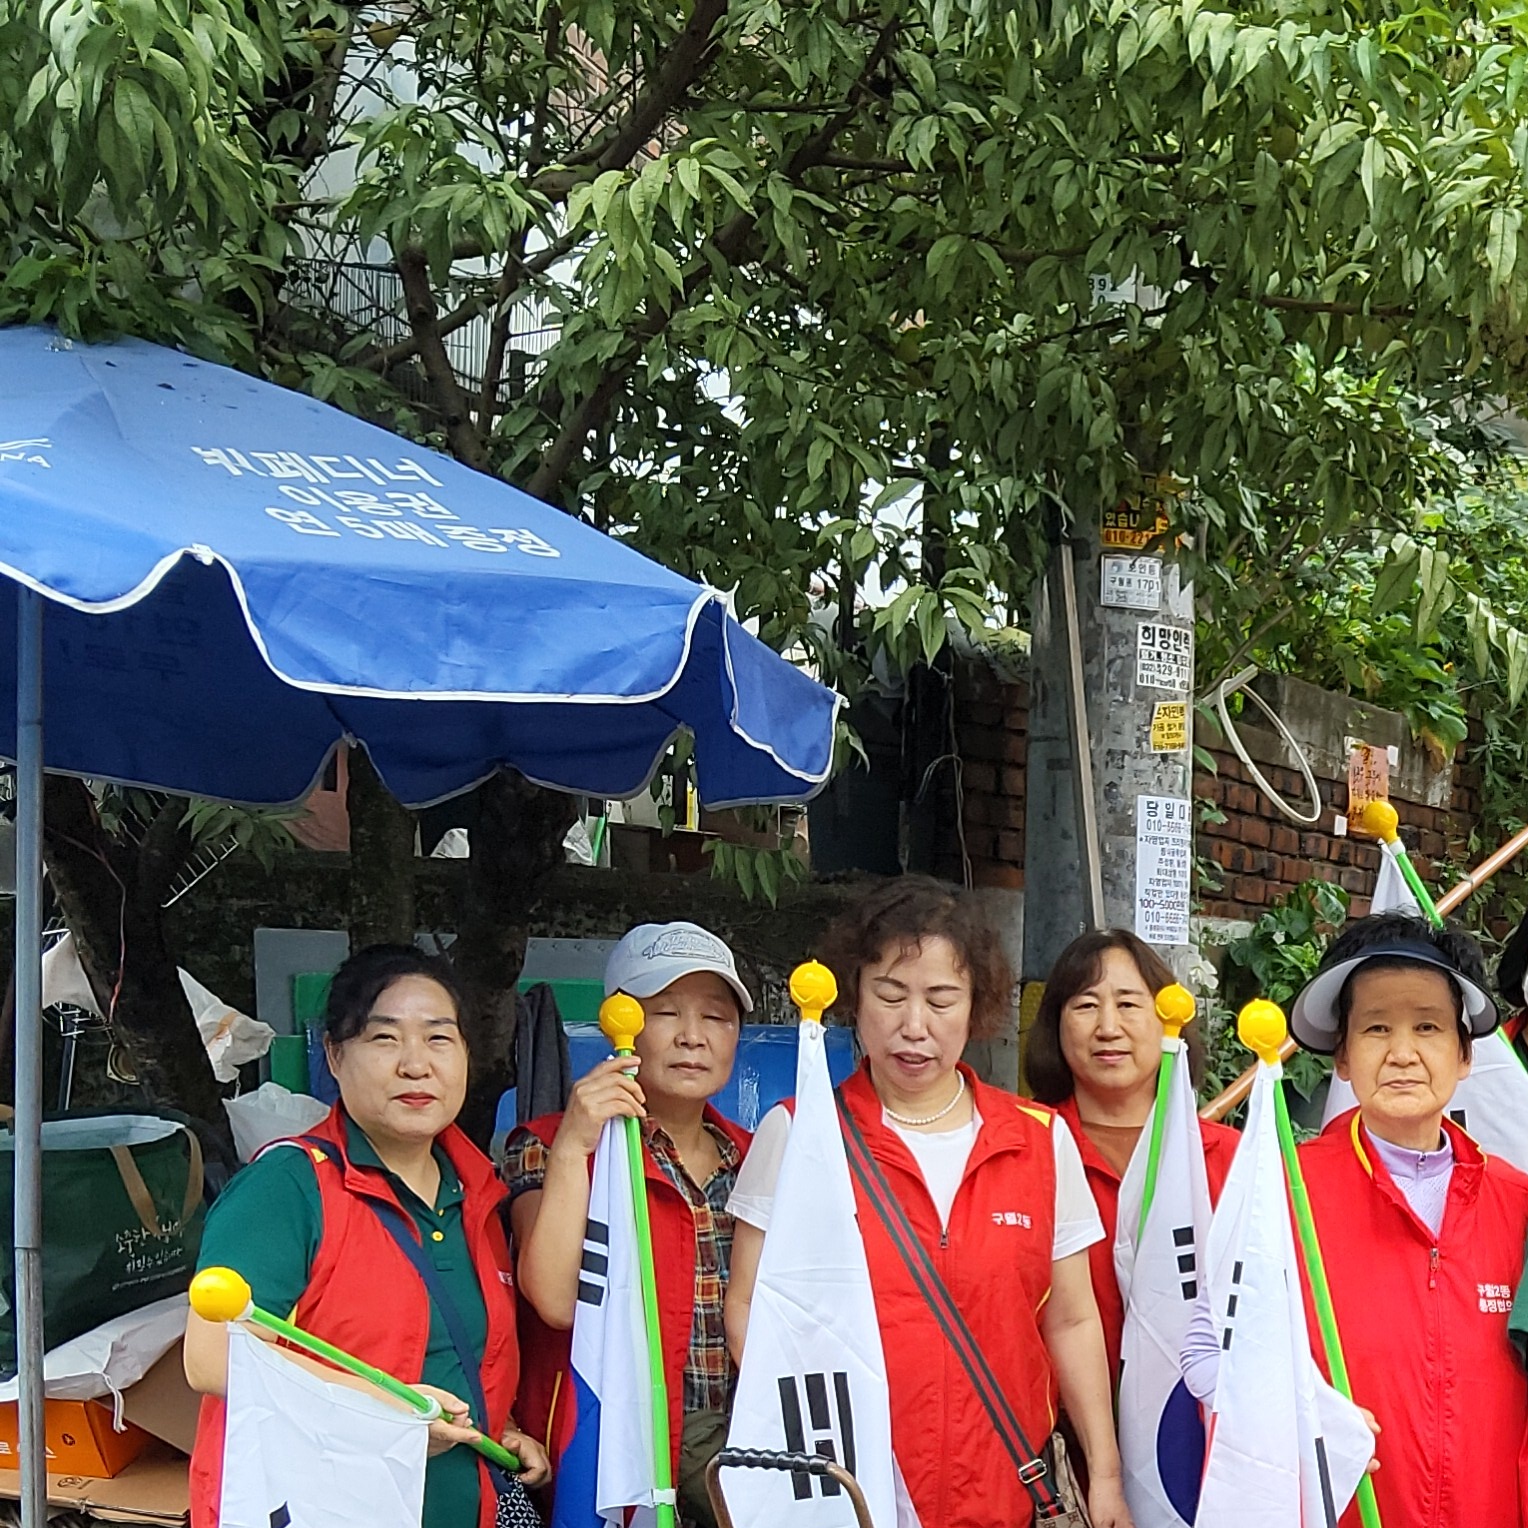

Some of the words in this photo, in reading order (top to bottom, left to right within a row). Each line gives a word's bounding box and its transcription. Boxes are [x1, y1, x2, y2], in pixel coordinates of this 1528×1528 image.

[278, 485, 460, 520] 이용권
[264, 507, 341, 537] 연
[335, 515, 449, 548] 5매
[435, 523, 561, 558] 증정
